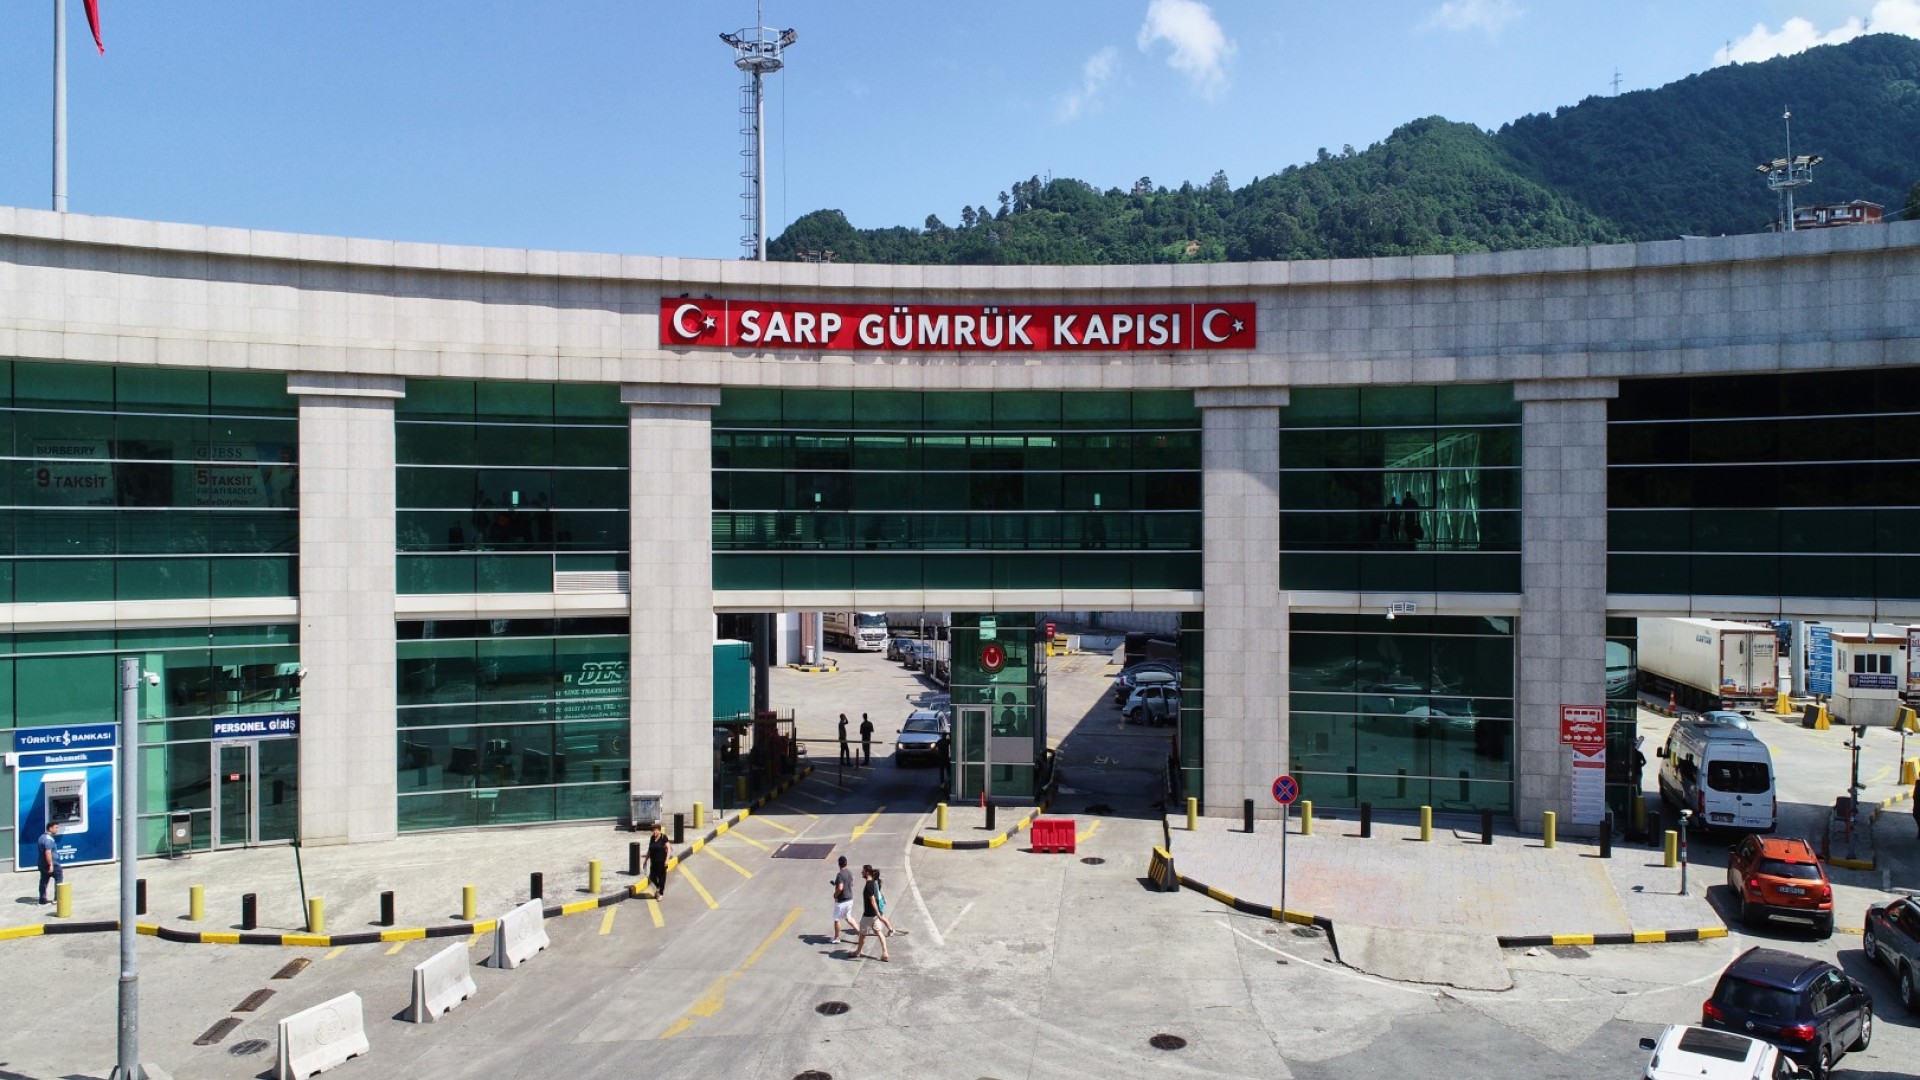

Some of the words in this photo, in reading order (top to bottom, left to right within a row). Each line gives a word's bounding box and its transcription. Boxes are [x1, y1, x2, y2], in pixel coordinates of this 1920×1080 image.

[739, 309, 843, 344] SARP
[858, 306, 1034, 347] GÜMRÜK
[1053, 313, 1181, 346] KAPISI
[37, 446, 96, 457] BURBERRY
[197, 447, 243, 458] GUESS
[37, 468, 50, 488] 9
[54, 475, 107, 488] TAKSİT
[197, 470, 208, 485] 5
[210, 474, 253, 486] TAKSİT
[214, 722, 267, 734] PERSONEL
[20, 735, 63, 745] TÜRKİYE
[71, 732, 111, 742] BANKASI
